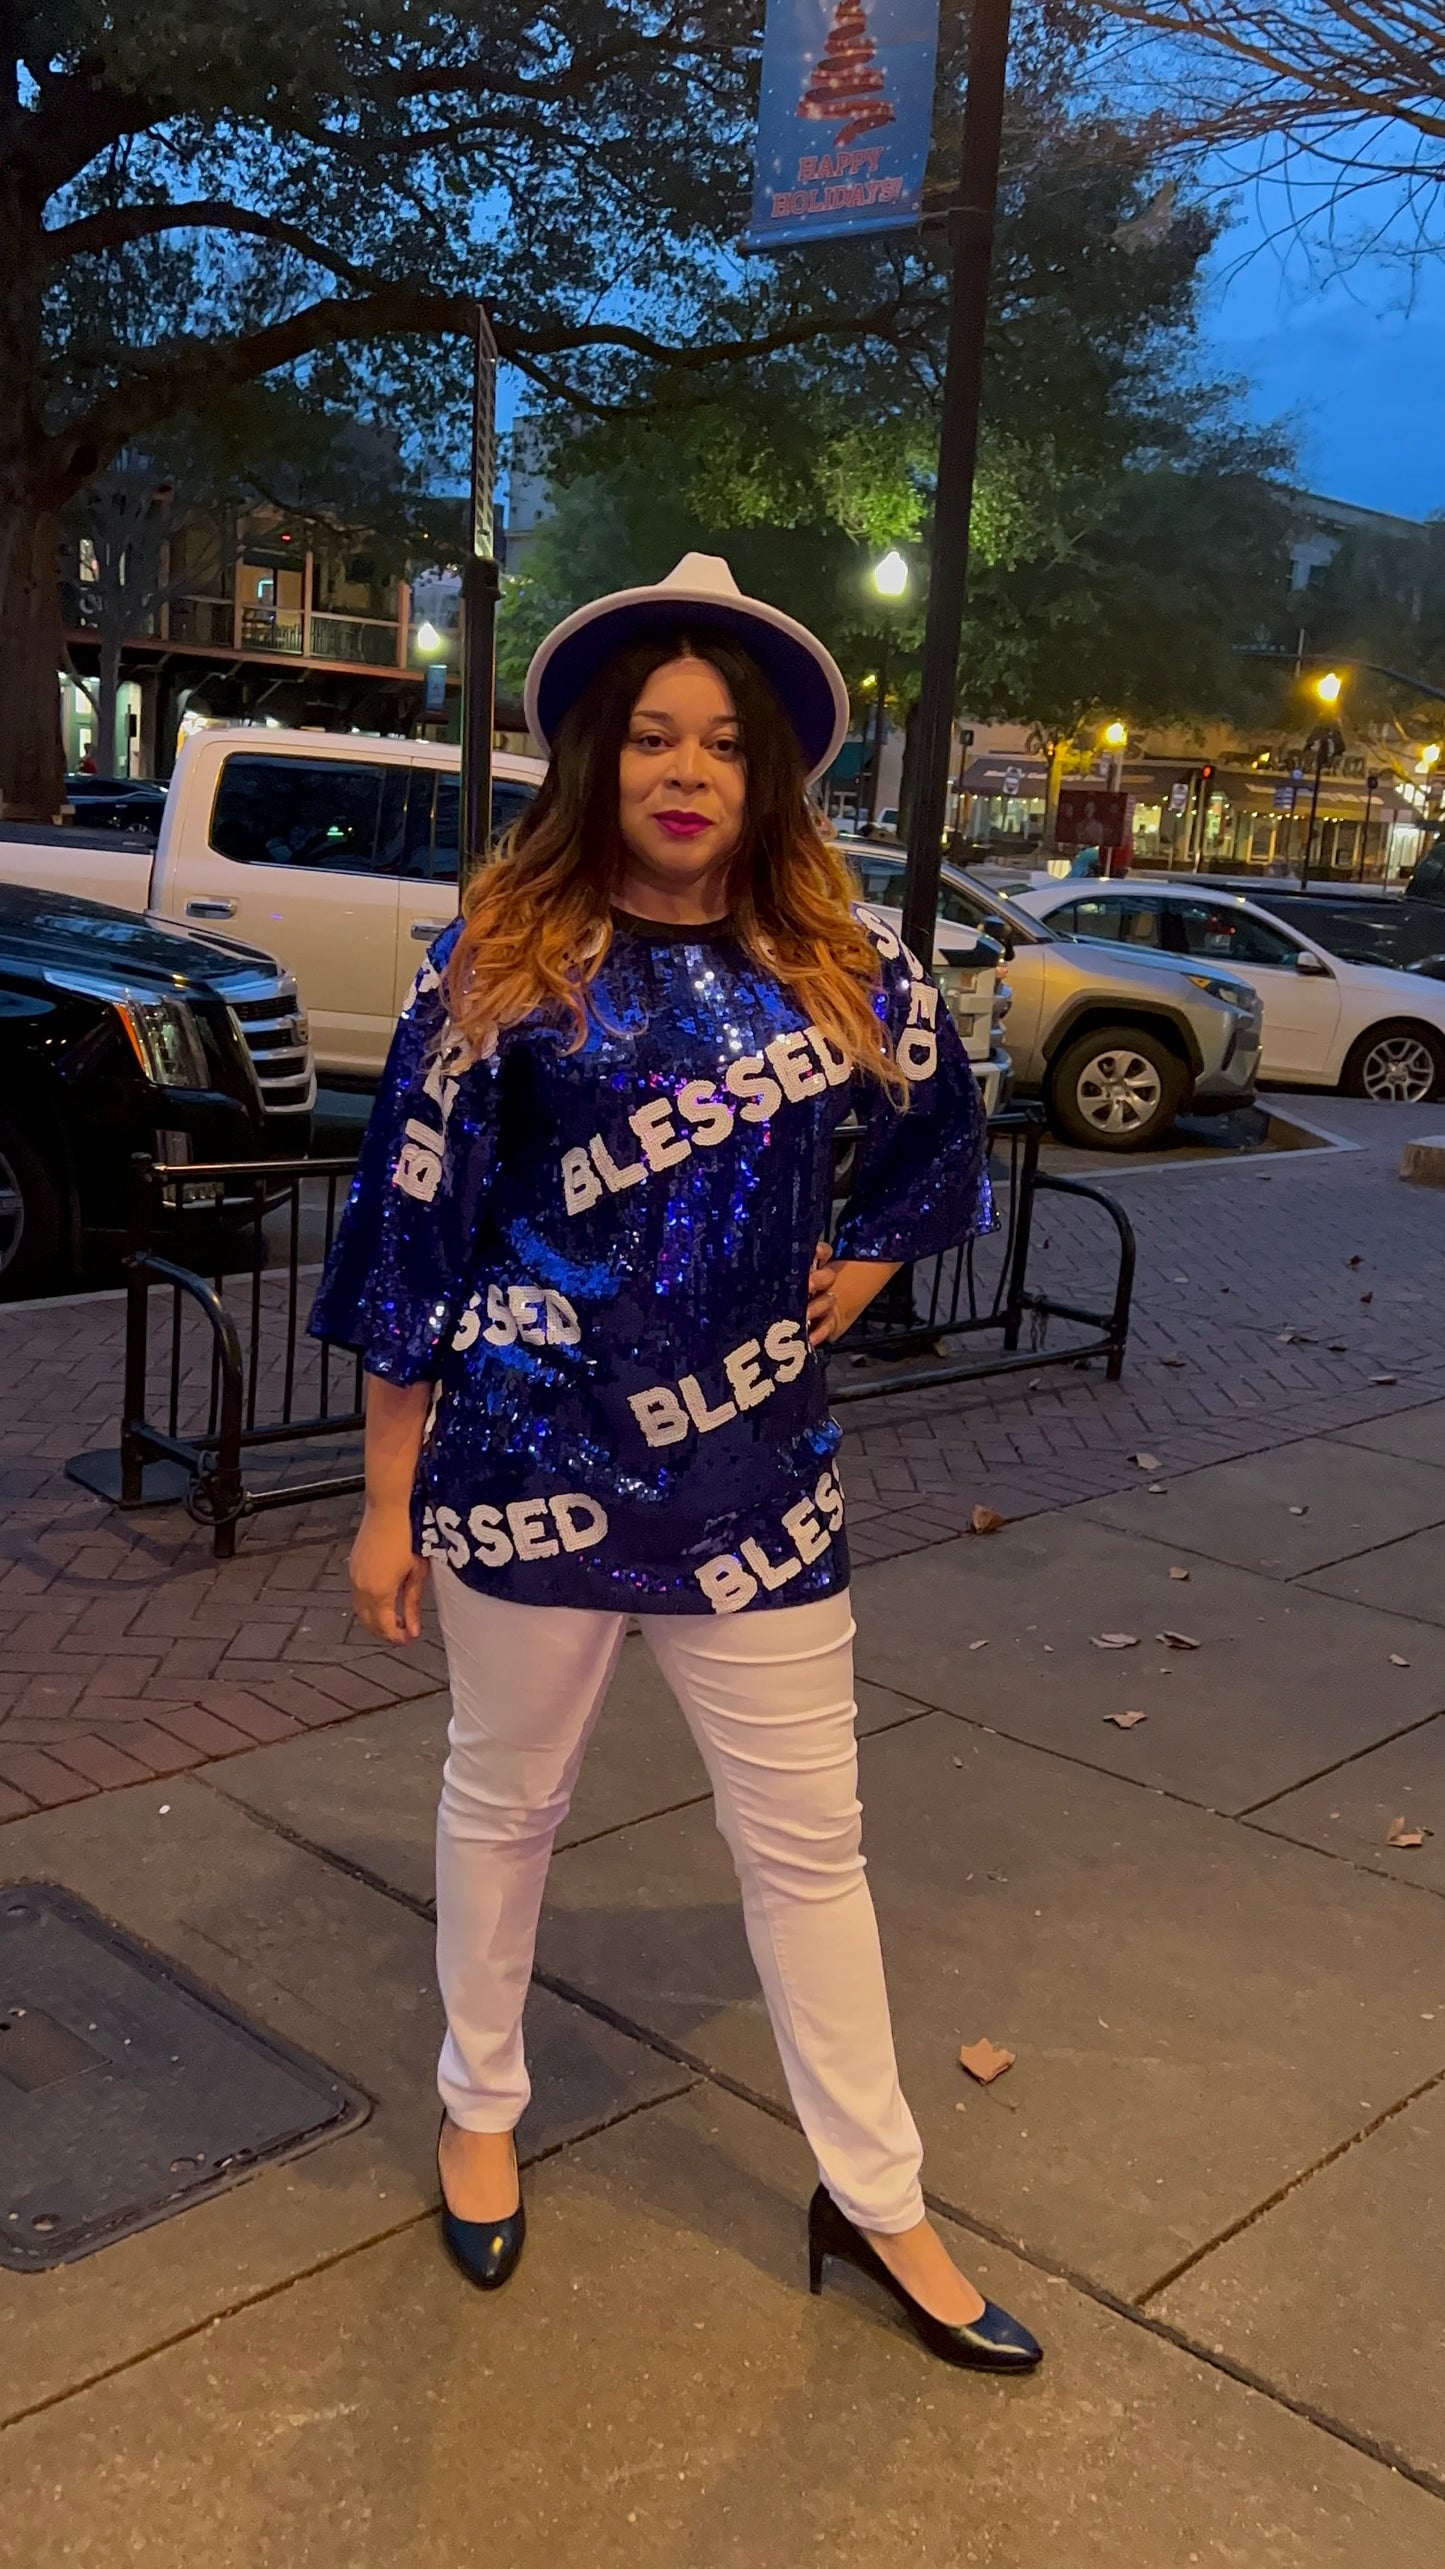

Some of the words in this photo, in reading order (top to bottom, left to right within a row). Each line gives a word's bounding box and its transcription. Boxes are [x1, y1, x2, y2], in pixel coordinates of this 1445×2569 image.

[772, 178, 903, 217] HOLIDAYS!
[798, 148, 883, 181] HAPPY
[561, 1026, 853, 1216] BLESSED
[627, 1319, 807, 1447] BLES
[694, 1458, 845, 1615] BLES
